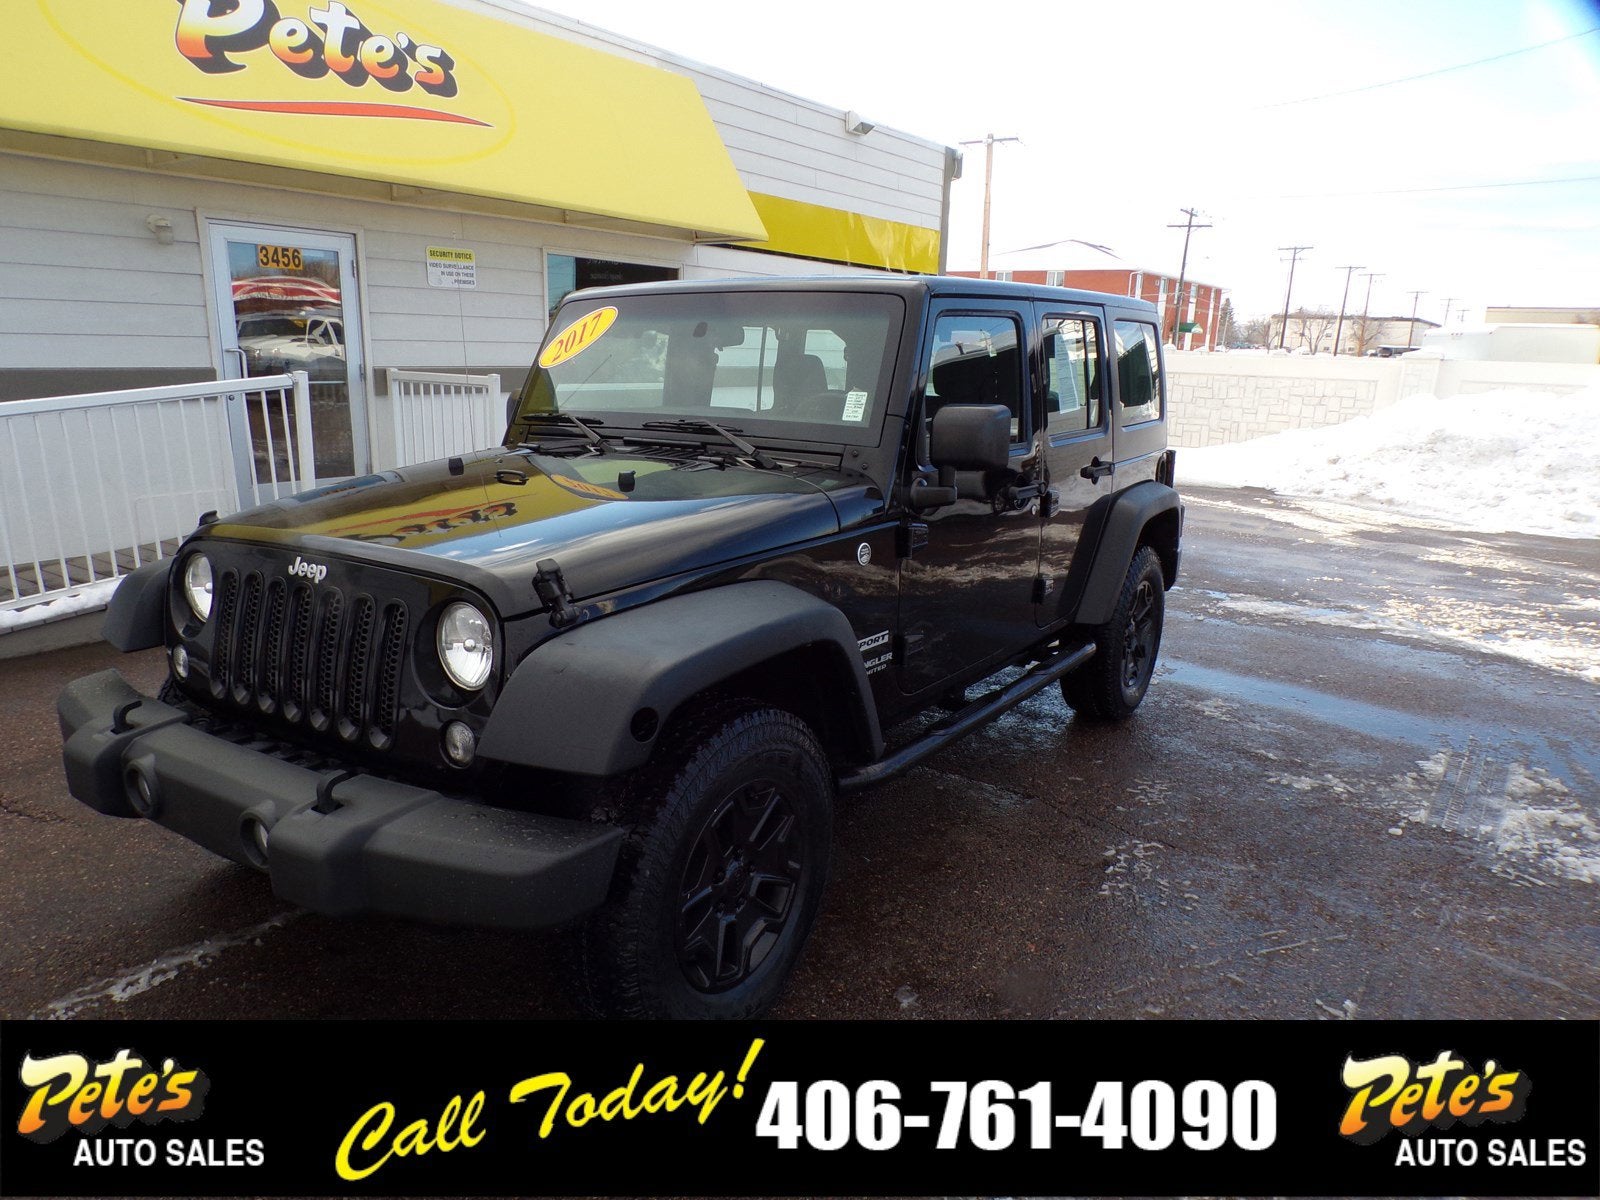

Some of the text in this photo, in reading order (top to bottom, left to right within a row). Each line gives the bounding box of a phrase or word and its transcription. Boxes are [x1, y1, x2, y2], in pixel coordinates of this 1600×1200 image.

[175, 0, 457, 97] Pete's
[258, 246, 302, 268] 3456
[429, 250, 472, 260] SECURITY NOTICE
[551, 312, 603, 363] 2017
[288, 556, 328, 584] Jeep
[857, 633, 889, 649] PORT
